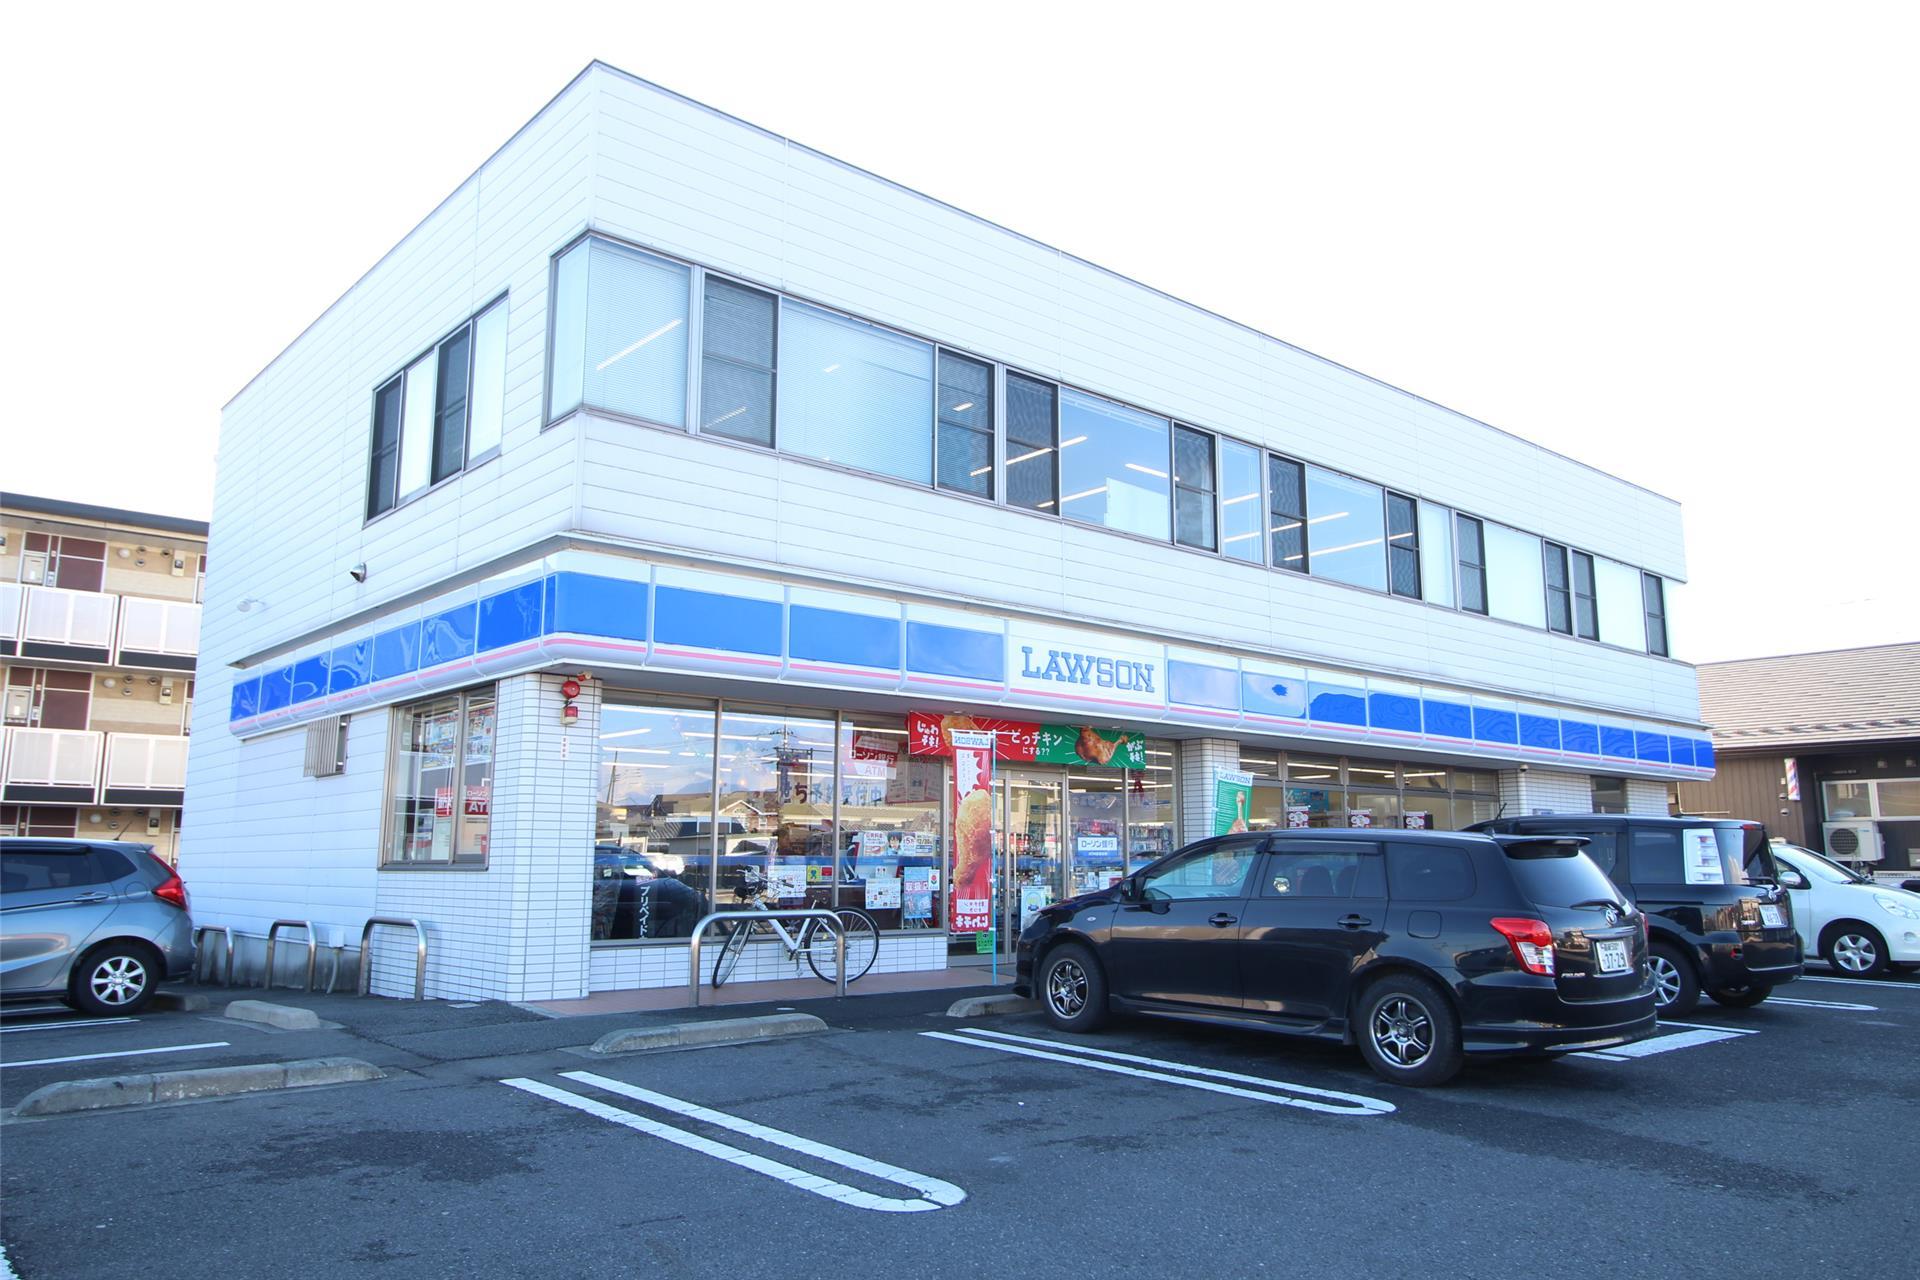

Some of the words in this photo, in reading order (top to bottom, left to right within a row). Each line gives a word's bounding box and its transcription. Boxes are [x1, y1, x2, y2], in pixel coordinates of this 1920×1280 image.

[1021, 646, 1155, 693] LAWSON
[1010, 729, 1062, 746] どっチキン
[849, 749, 895, 764] ローソン銀行
[865, 766, 886, 777] ATM
[1219, 772, 1251, 784] LAWSON
[1081, 840, 1114, 848] ローソン銀行
[640, 885, 650, 938] プリペイド
[1604, 952, 1626, 969] 37-29
